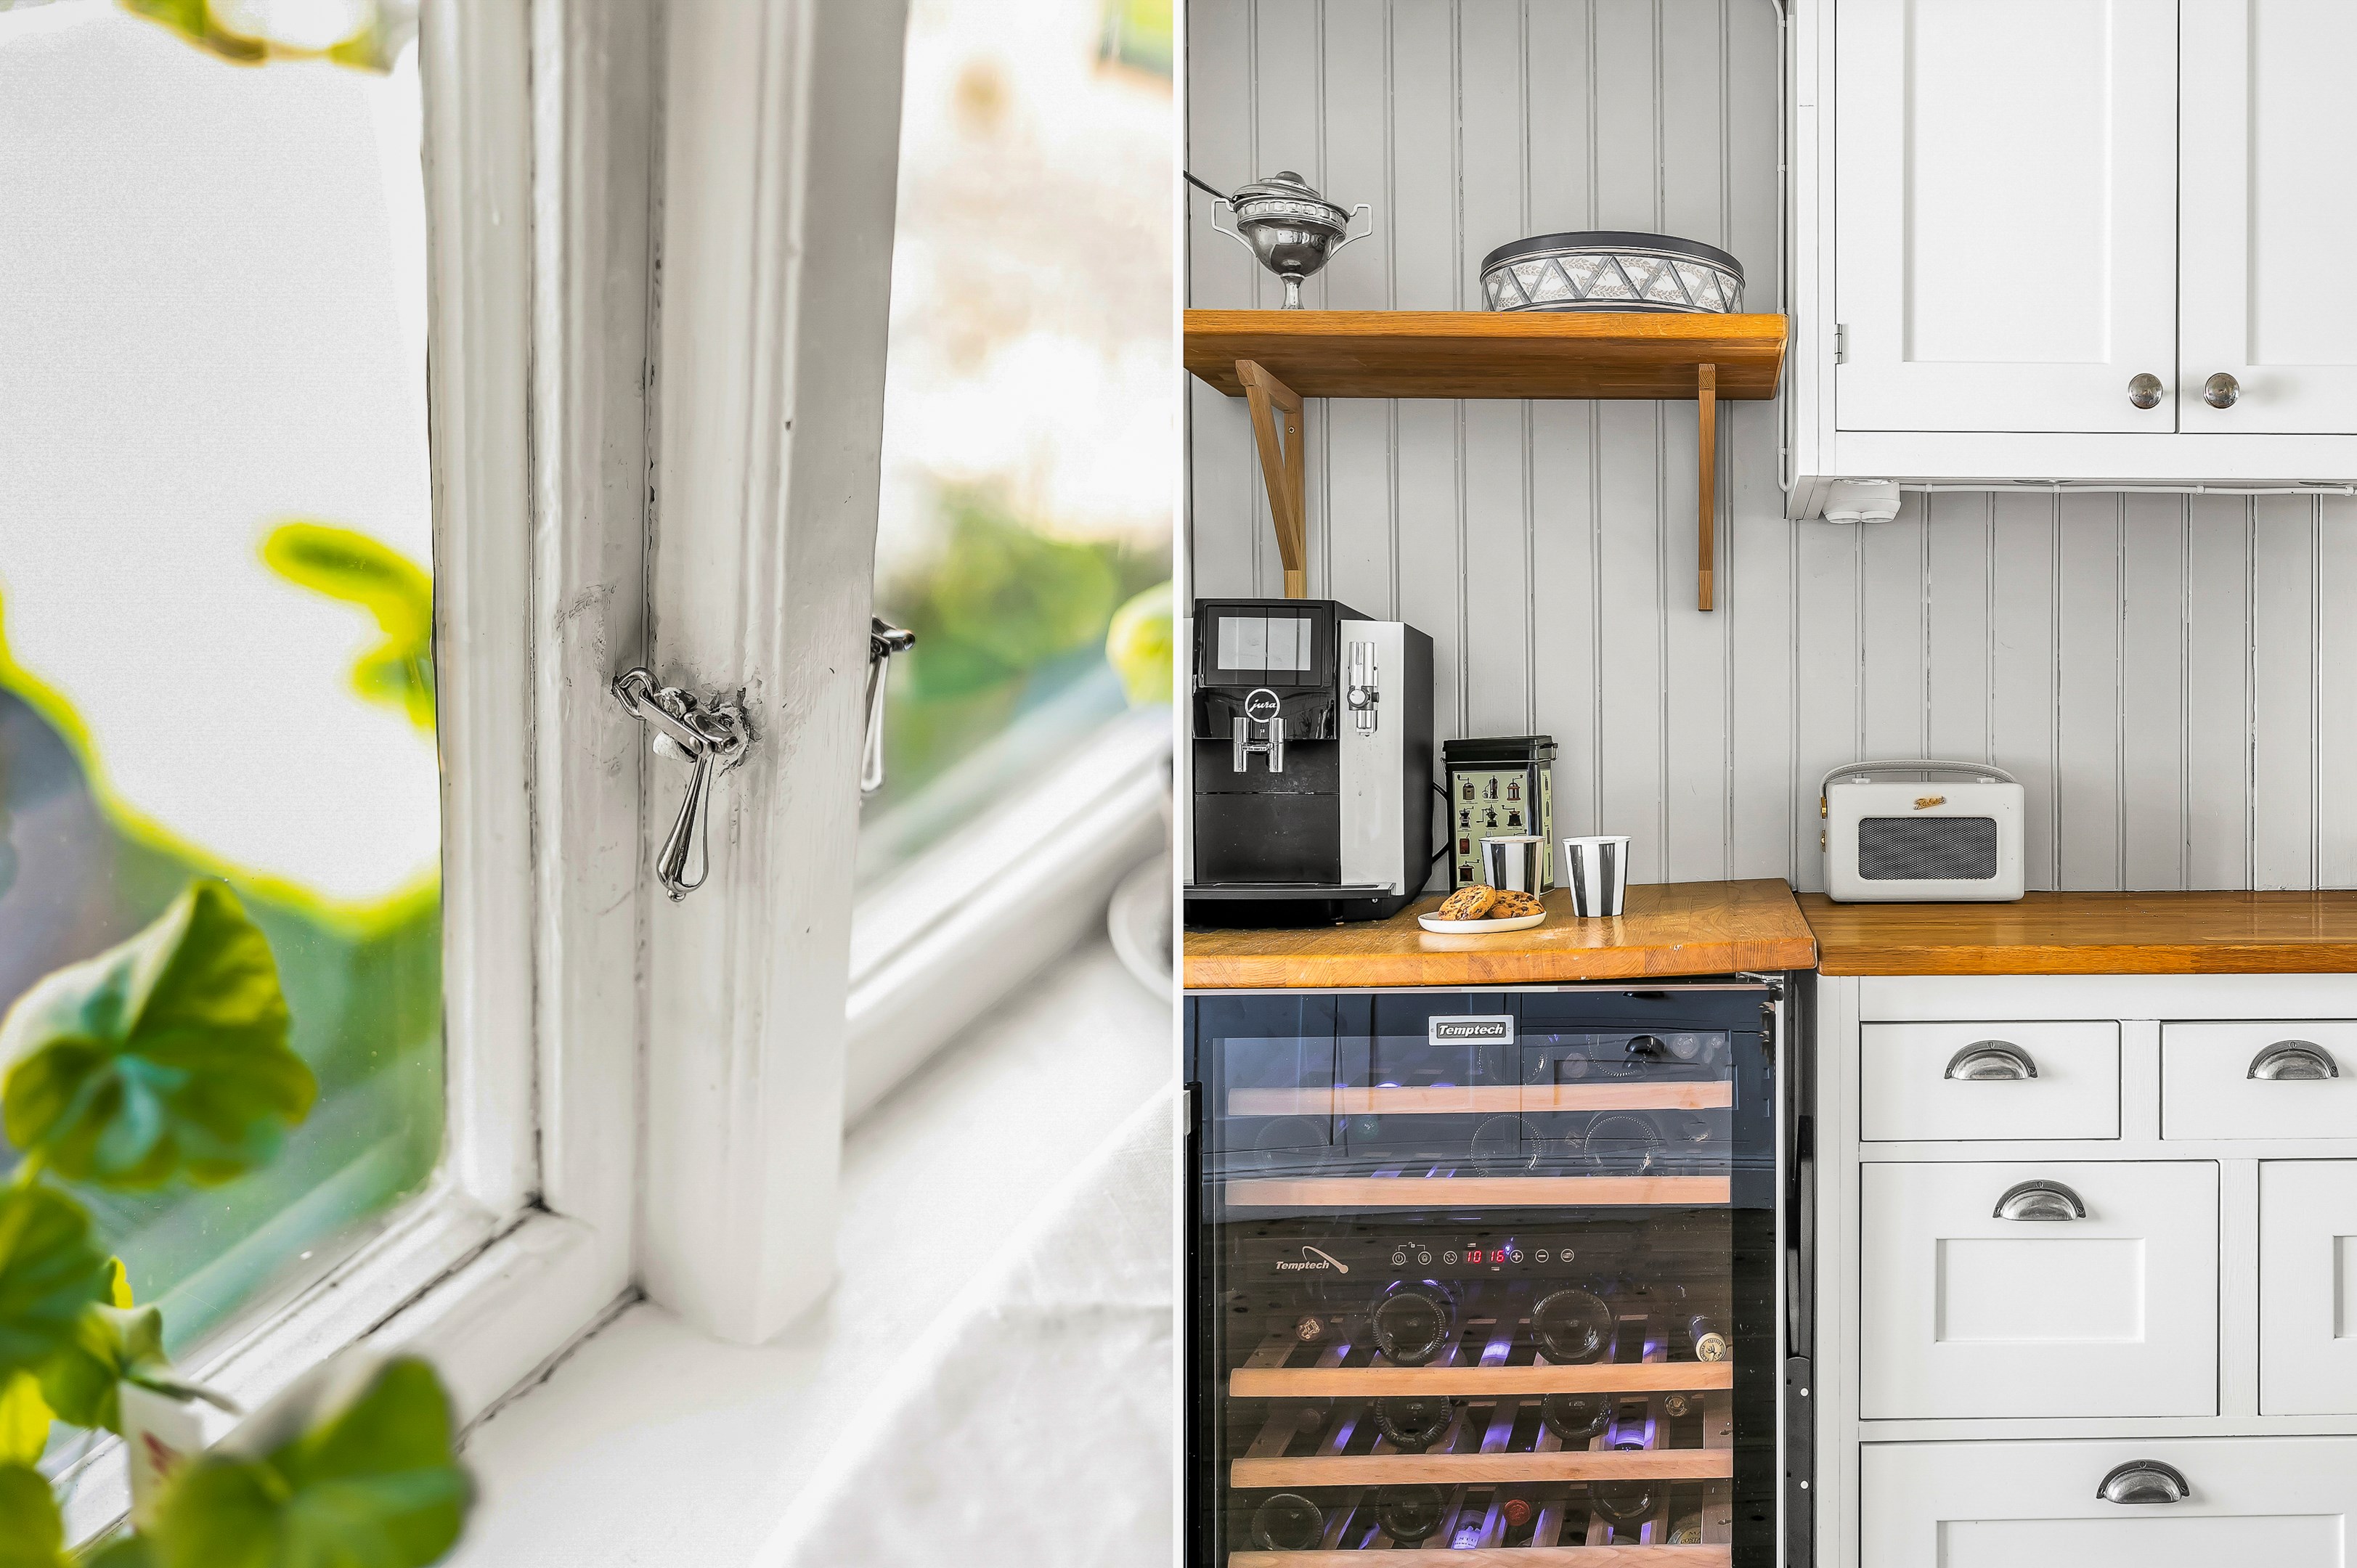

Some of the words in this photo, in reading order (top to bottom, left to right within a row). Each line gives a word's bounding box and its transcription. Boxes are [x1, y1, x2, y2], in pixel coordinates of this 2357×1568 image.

[1248, 699, 1277, 712] jura
[1439, 1024, 1504, 1037] Temptech
[1467, 1250, 1482, 1263] 10
[1490, 1249, 1505, 1263] 16
[1276, 1260, 1330, 1271] Temptech
